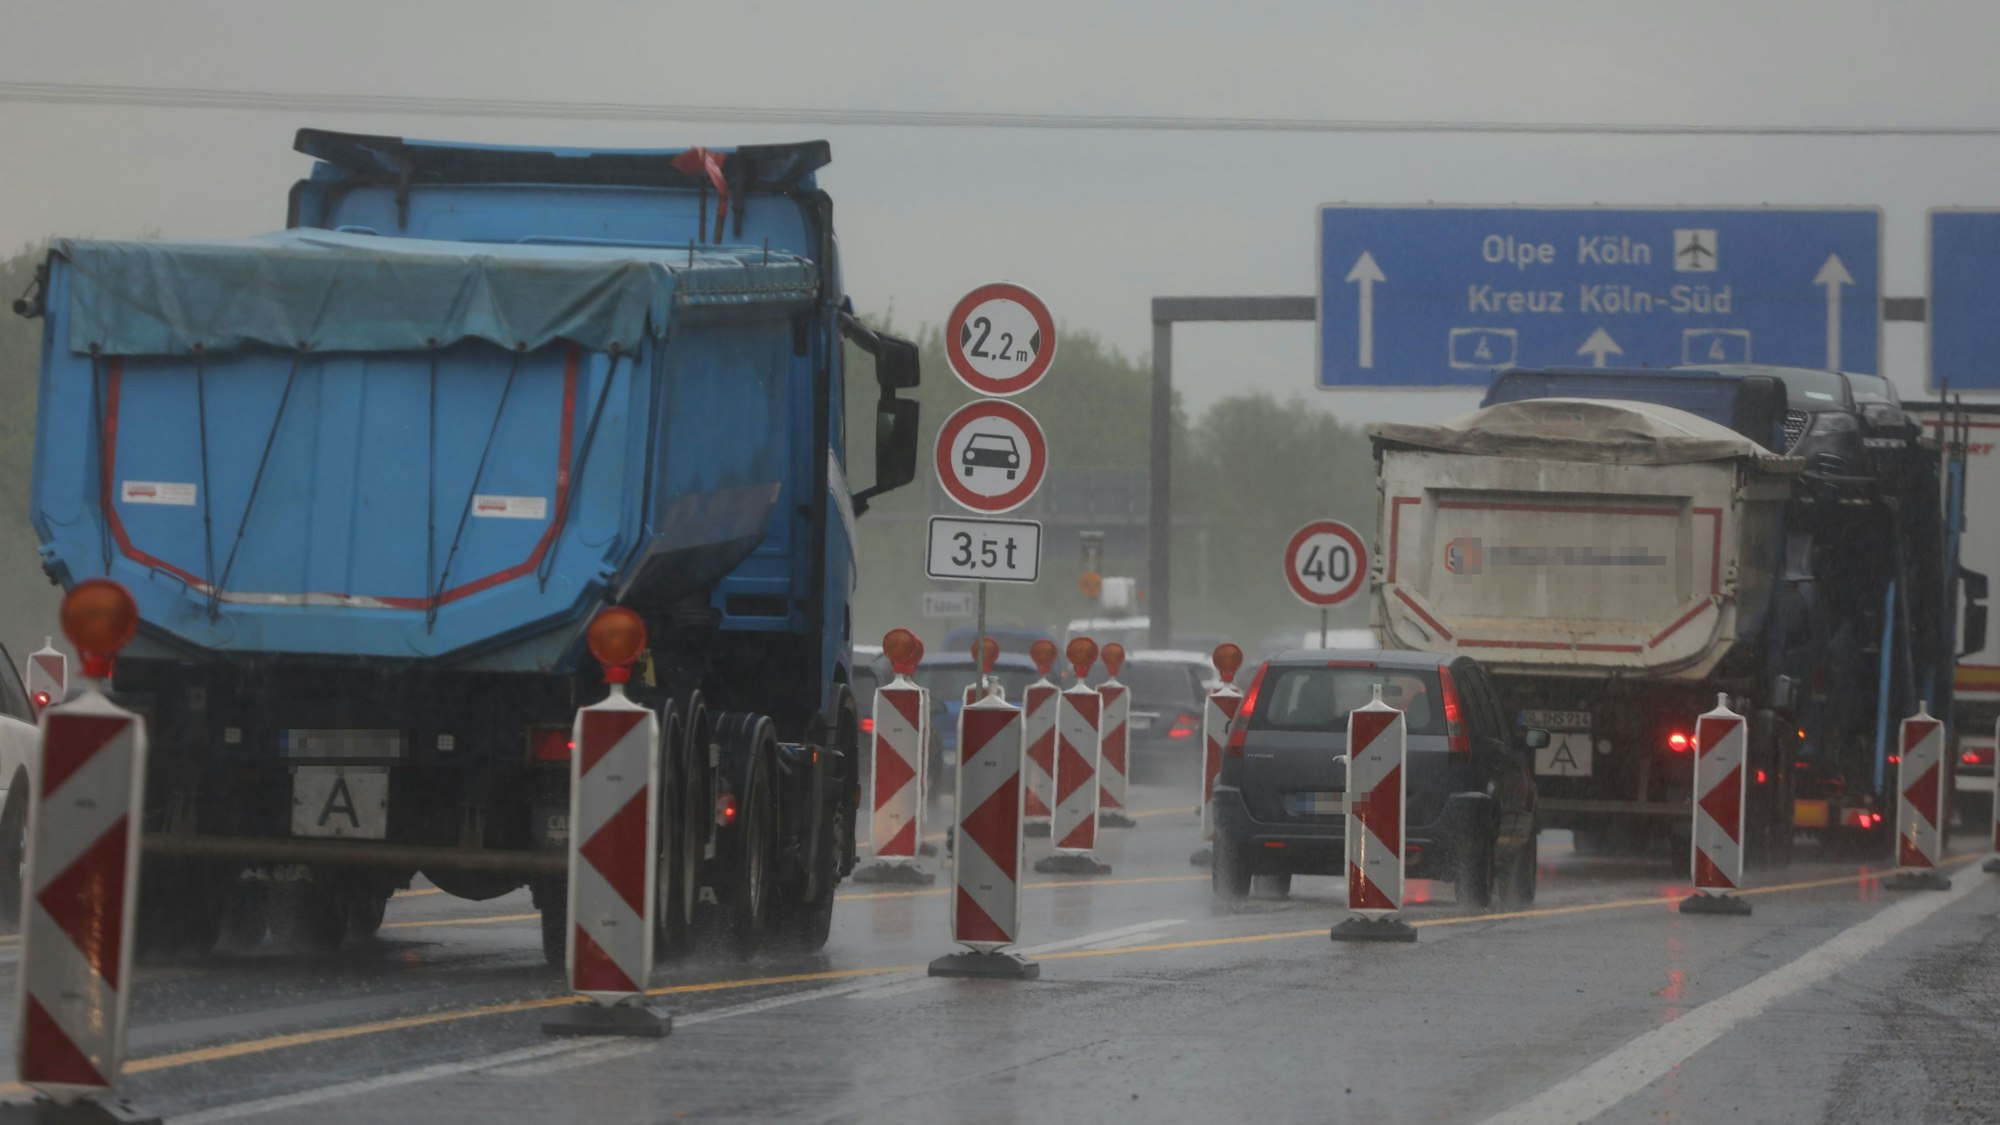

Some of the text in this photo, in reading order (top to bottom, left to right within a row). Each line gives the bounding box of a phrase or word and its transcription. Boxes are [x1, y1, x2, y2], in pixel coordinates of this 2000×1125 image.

[1482, 234, 1651, 270] Olpe Köln
[1468, 284, 1731, 313] Kreuz Köln-Süd
[971, 316, 1013, 360] 2,2
[1473, 336, 1492, 359] 4
[1708, 337, 1725, 360] 4
[951, 531, 1017, 569] 3,5 t
[1302, 544, 1350, 582] 40
[1548, 738, 1579, 769] A
[317, 777, 361, 828] A
